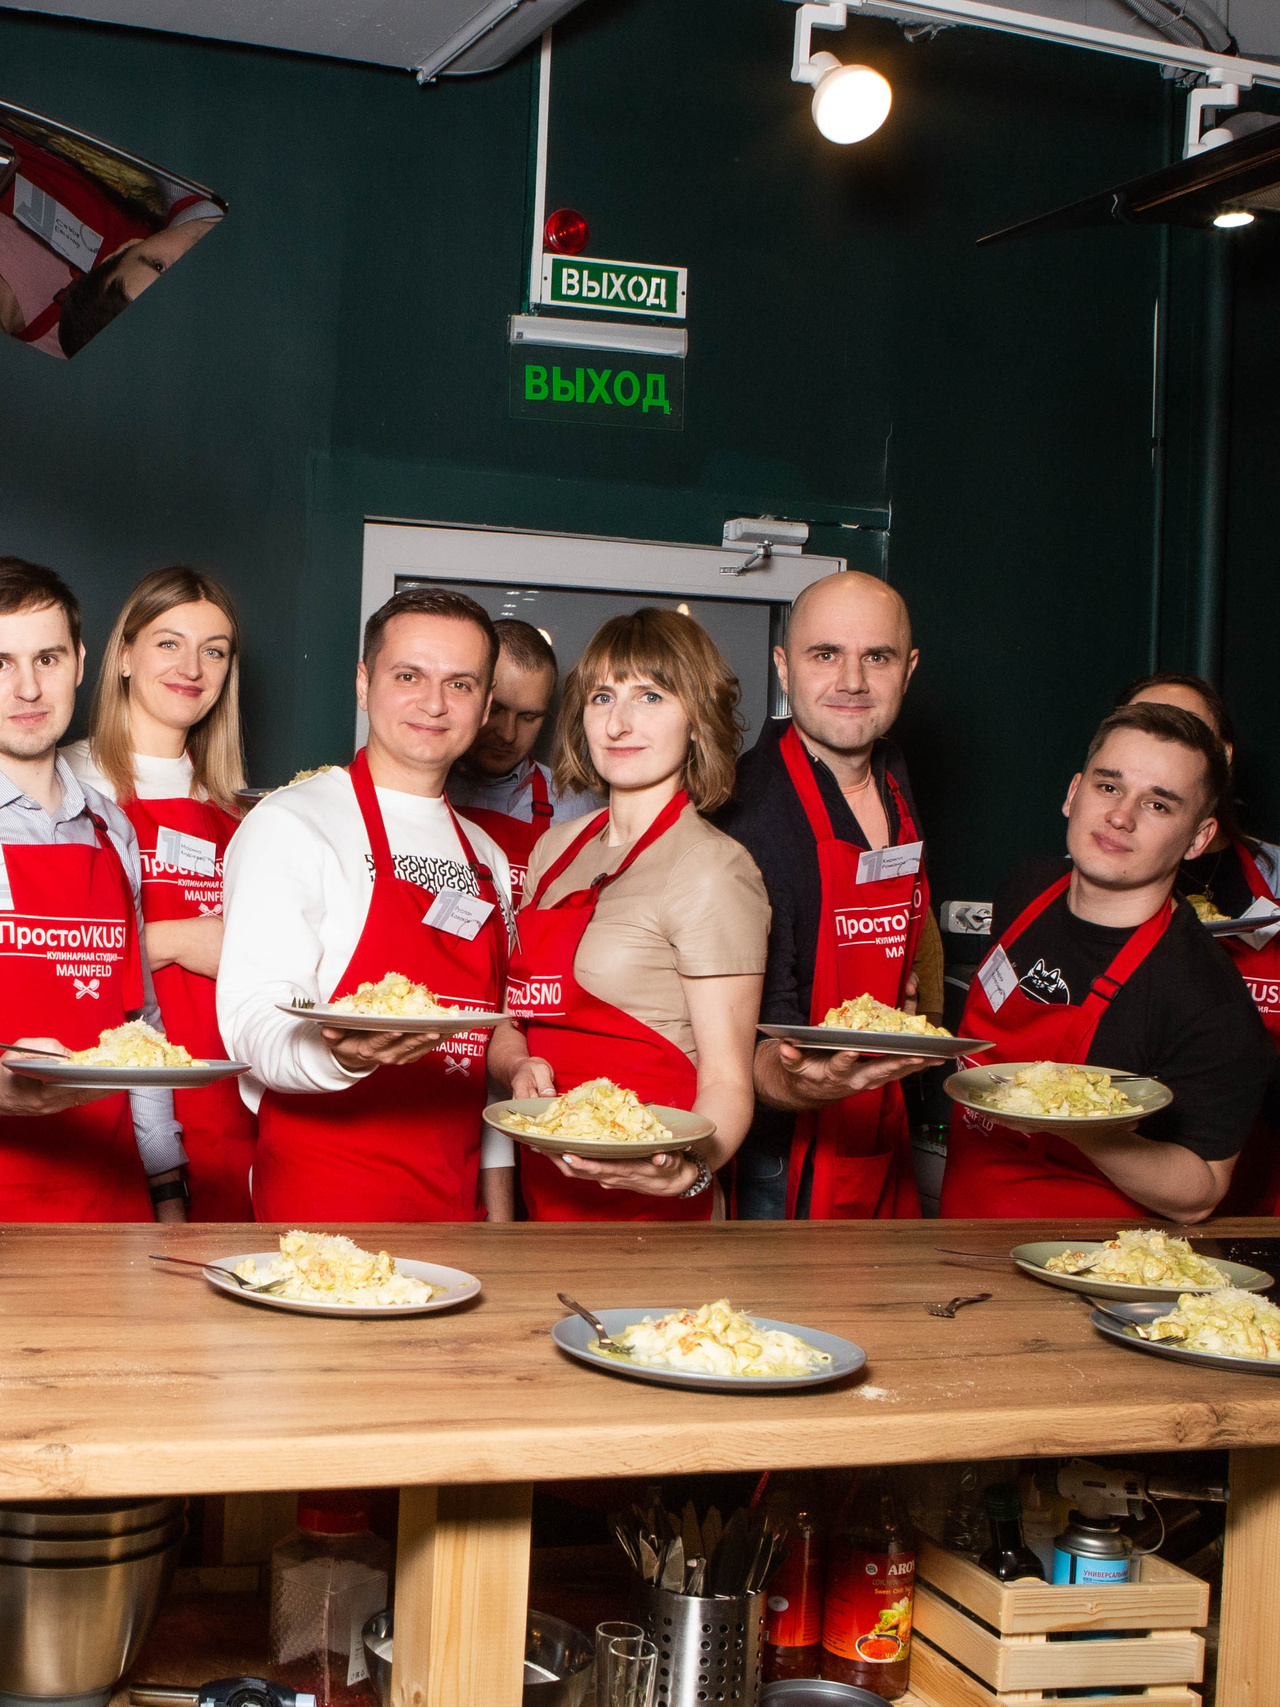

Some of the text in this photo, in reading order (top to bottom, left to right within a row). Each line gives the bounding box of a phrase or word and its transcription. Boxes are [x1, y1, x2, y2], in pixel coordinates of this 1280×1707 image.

[561, 267, 667, 308] ВЫХОД
[524, 364, 670, 415] ВЫХОД
[177, 878, 219, 889] КУЛИНАРНАЯ
[184, 889, 224, 902] MAUNFE
[875, 933, 907, 945] КУЛИНА
[46, 950, 95, 961] КУЛИНАРНАЯ
[55, 963, 113, 978] MAUNFELD
